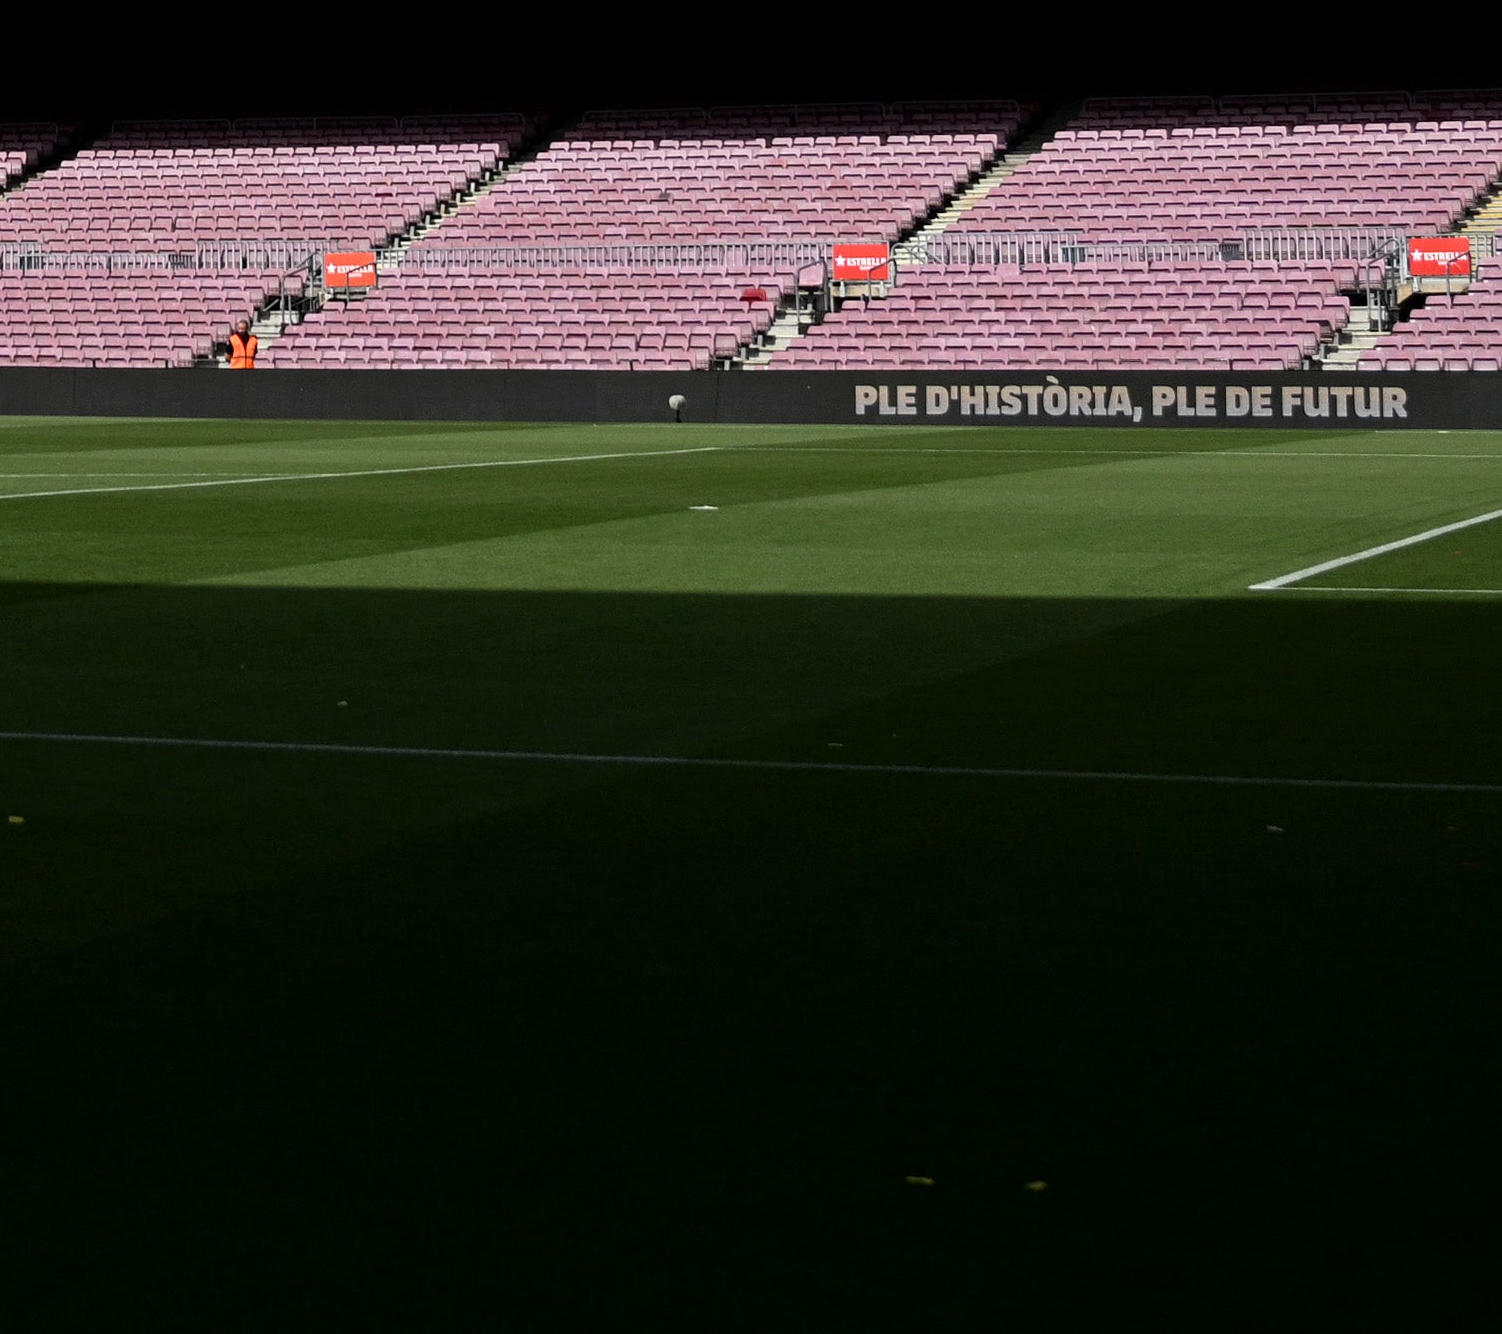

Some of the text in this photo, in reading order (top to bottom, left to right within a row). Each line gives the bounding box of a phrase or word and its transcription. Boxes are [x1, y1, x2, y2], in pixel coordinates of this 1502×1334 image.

[854, 375, 1407, 423] PLE D'HISTÒRIA, PLE DE FUTUR
